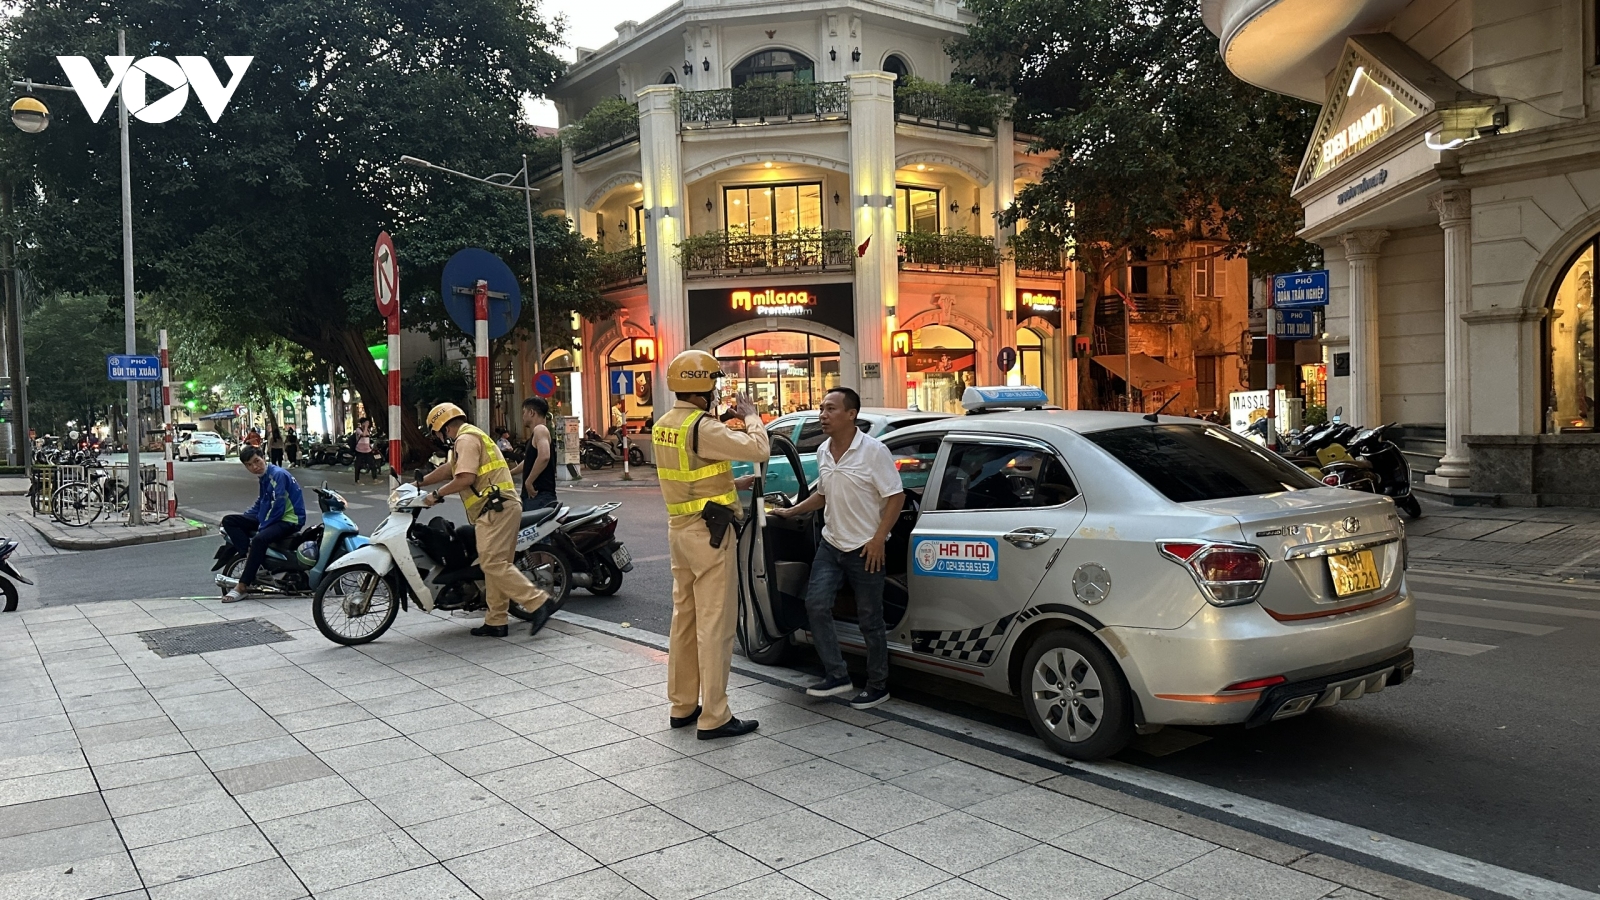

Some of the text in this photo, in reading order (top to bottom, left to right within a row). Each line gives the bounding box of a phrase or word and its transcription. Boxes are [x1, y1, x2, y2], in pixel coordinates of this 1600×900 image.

[1322, 104, 1386, 163] EDEN HANOI
[1295, 274, 1312, 285] PHỐ
[753, 289, 808, 306] milana
[1277, 288, 1291, 302] ĐOÀN
[1306, 285, 1324, 301] NGHIỆP
[757, 304, 804, 315] Premium
[112, 366, 157, 378] BÙI THỊ XUÂN
[680, 370, 709, 379] CSGT
[430, 407, 447, 425] CSGT
[654, 429, 679, 445] C.S.G.T
[939, 541, 989, 560] HÀ NỘI
[946, 561, 989, 572] 024.35.58.53.53
[1341, 552, 1365, 571] 29H
